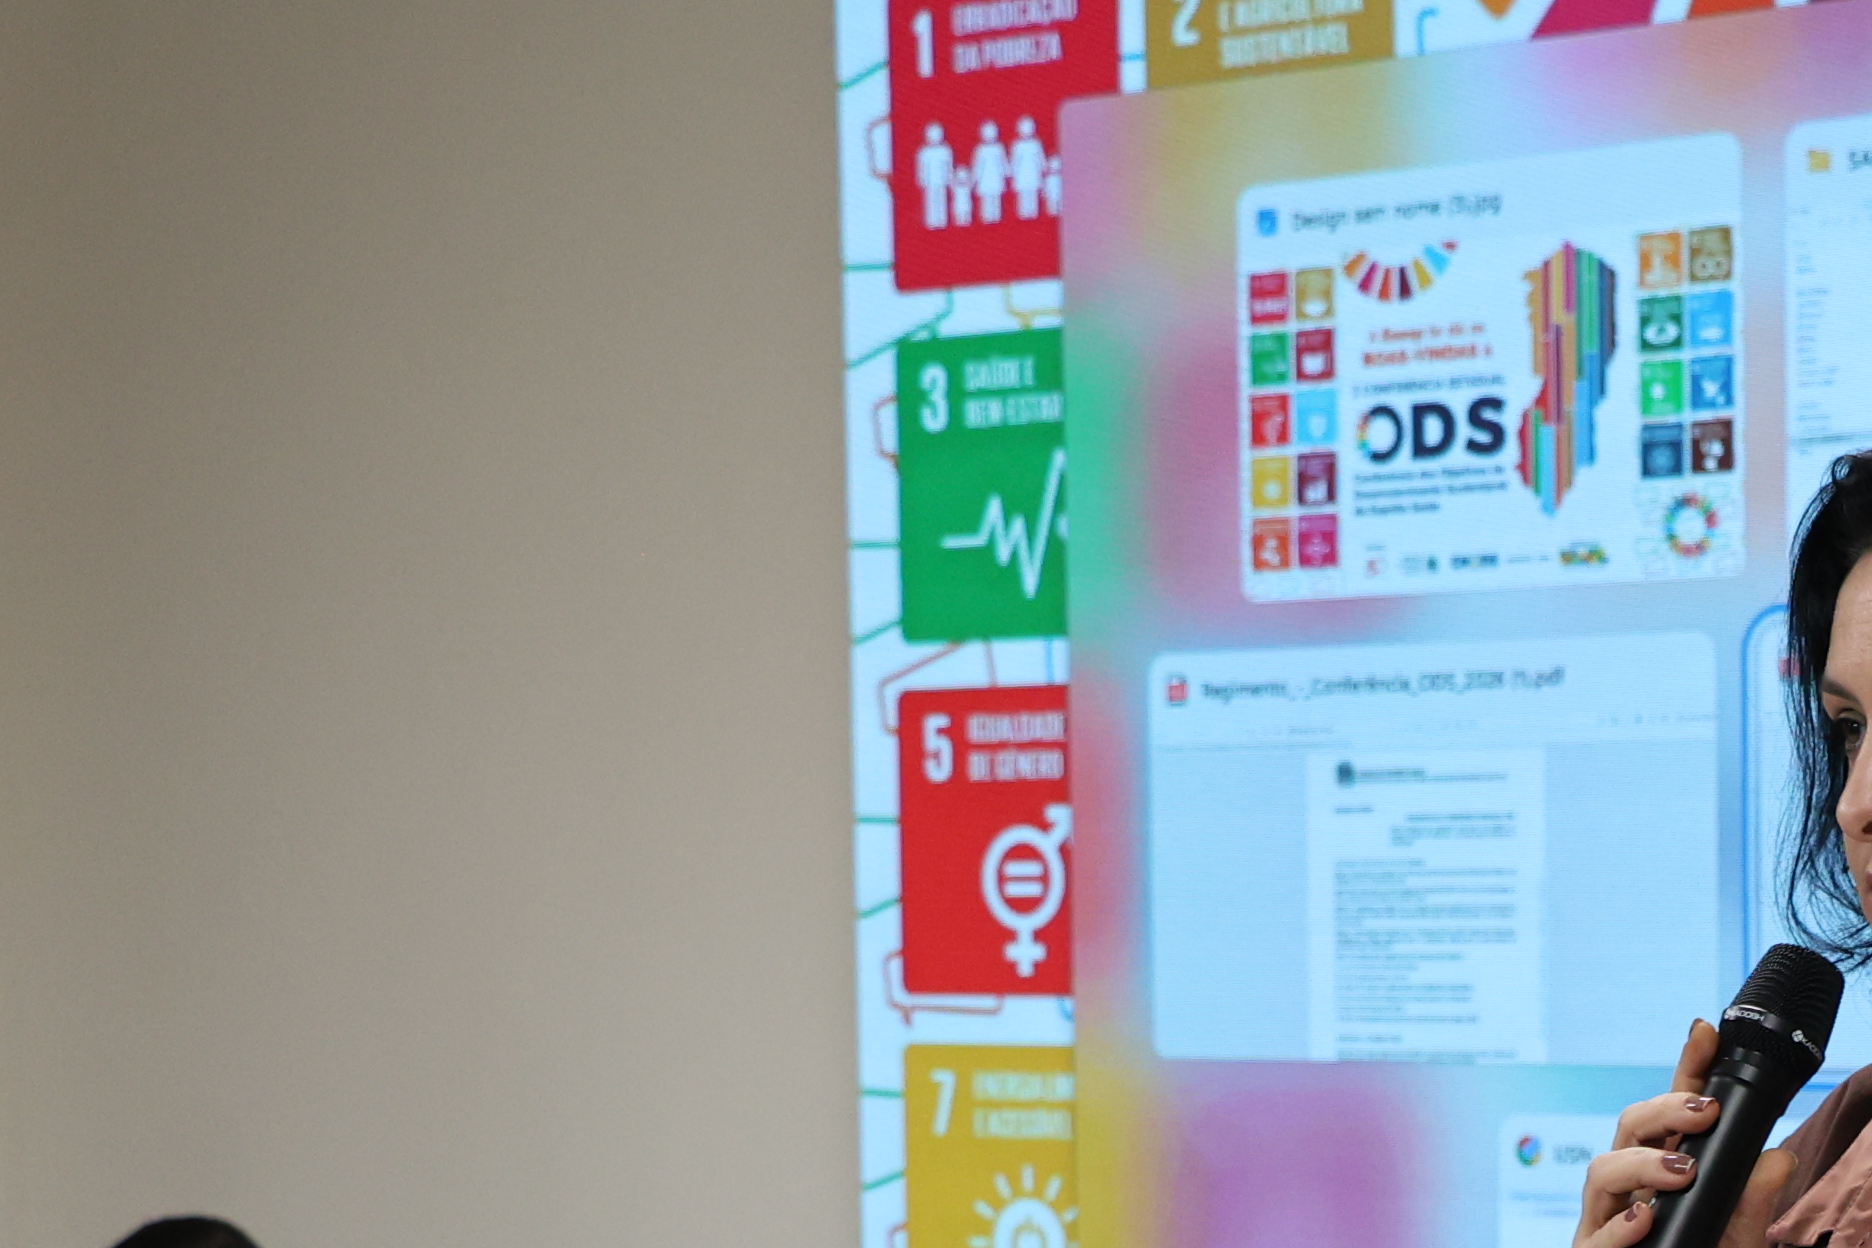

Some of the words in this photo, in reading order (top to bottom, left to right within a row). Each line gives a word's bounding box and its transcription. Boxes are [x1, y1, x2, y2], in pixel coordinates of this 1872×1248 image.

[911, 8, 934, 78] 1
[952, 43, 981, 74] DA
[981, 30, 1063, 69] POBREZA
[1171, 0, 1200, 47] 2
[1292, 207, 1347, 234] Design
[918, 361, 949, 435] 3
[1356, 395, 1506, 464] ODS
[922, 713, 953, 784] 5
[929, 1068, 956, 1138] 7
